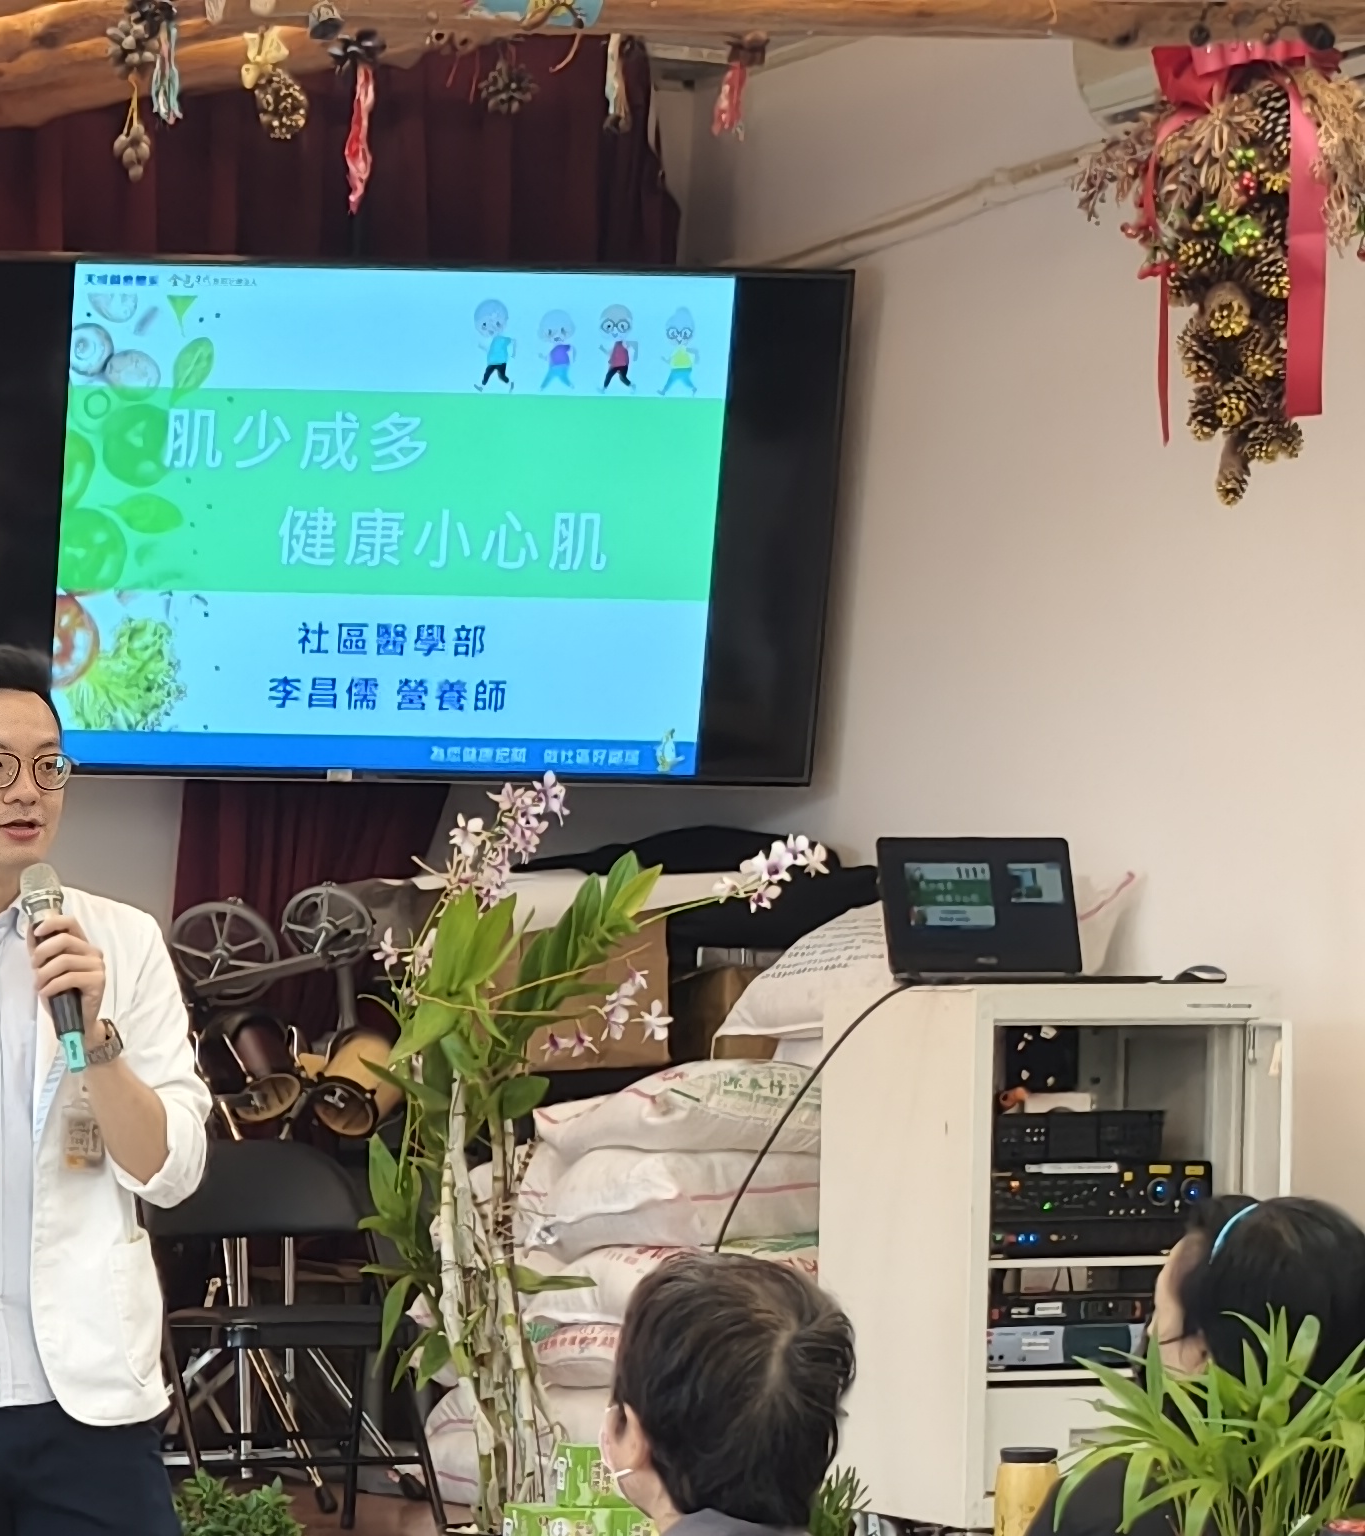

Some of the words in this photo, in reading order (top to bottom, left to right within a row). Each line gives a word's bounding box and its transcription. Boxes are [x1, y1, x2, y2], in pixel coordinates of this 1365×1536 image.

[164, 408, 428, 472] 肌少成多
[278, 506, 607, 571] 健康小心肌
[297, 622, 486, 658] 社區醫學部
[268, 676, 378, 711] 李昌儒
[396, 678, 508, 712] 營養師
